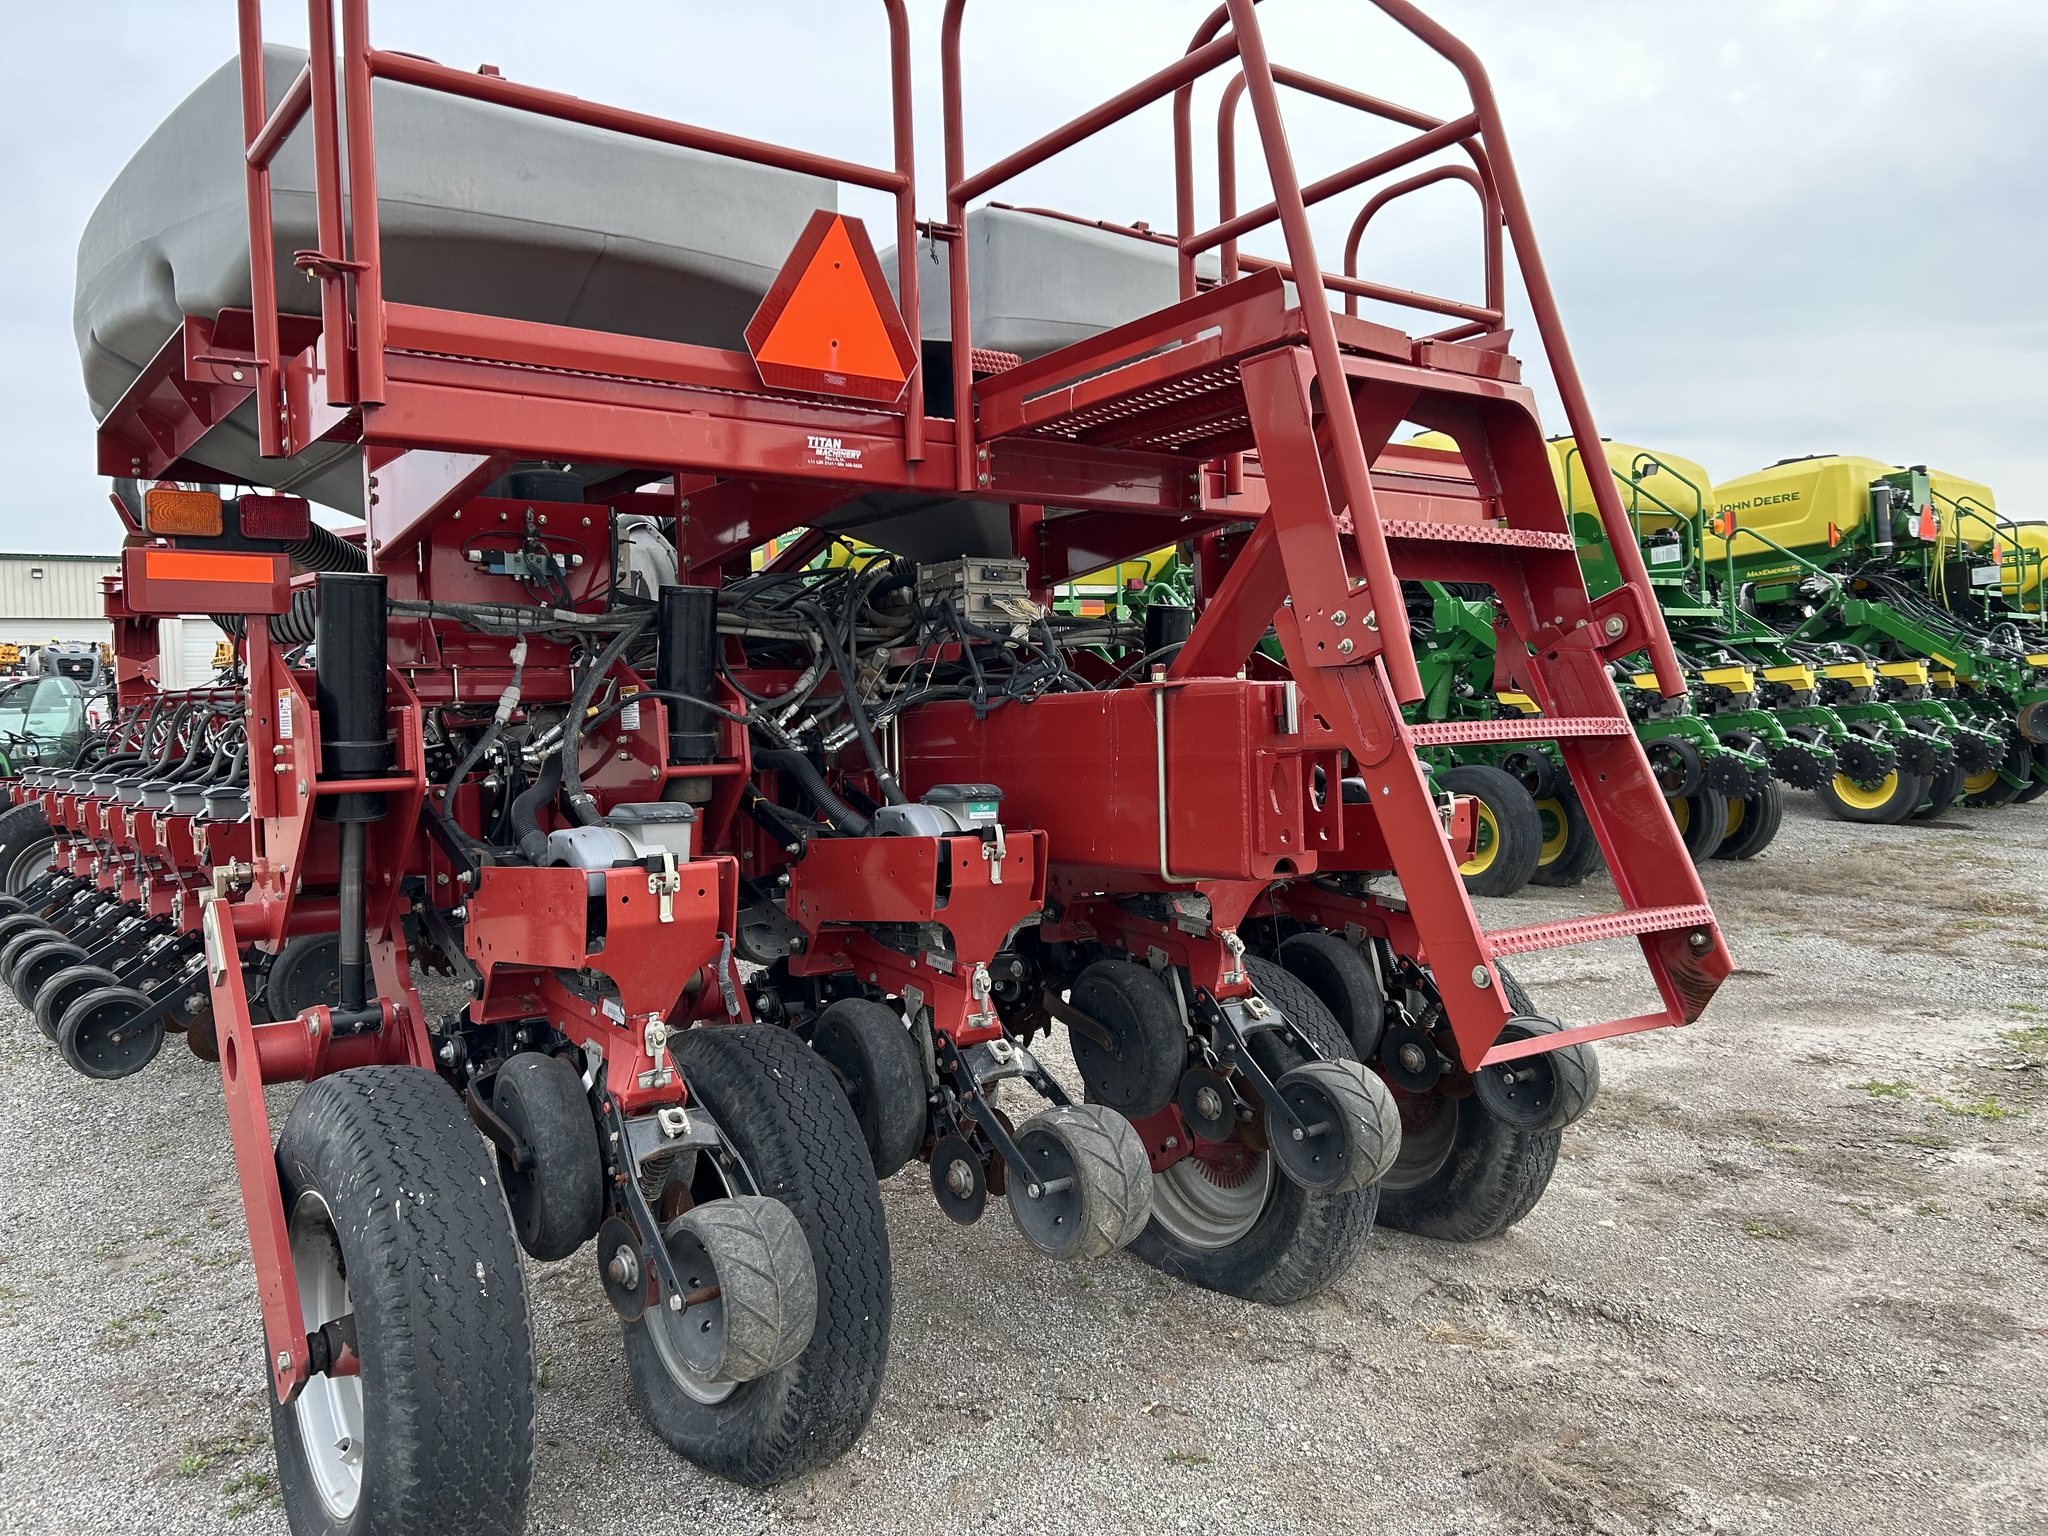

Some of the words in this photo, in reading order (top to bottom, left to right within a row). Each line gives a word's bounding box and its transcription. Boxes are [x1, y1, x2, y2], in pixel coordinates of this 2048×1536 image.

[807, 436, 842, 449] TITAN
[815, 448, 861, 460] MACHINERY
[1717, 500, 1750, 514] JOHN
[1753, 492, 1800, 507] DEERE
